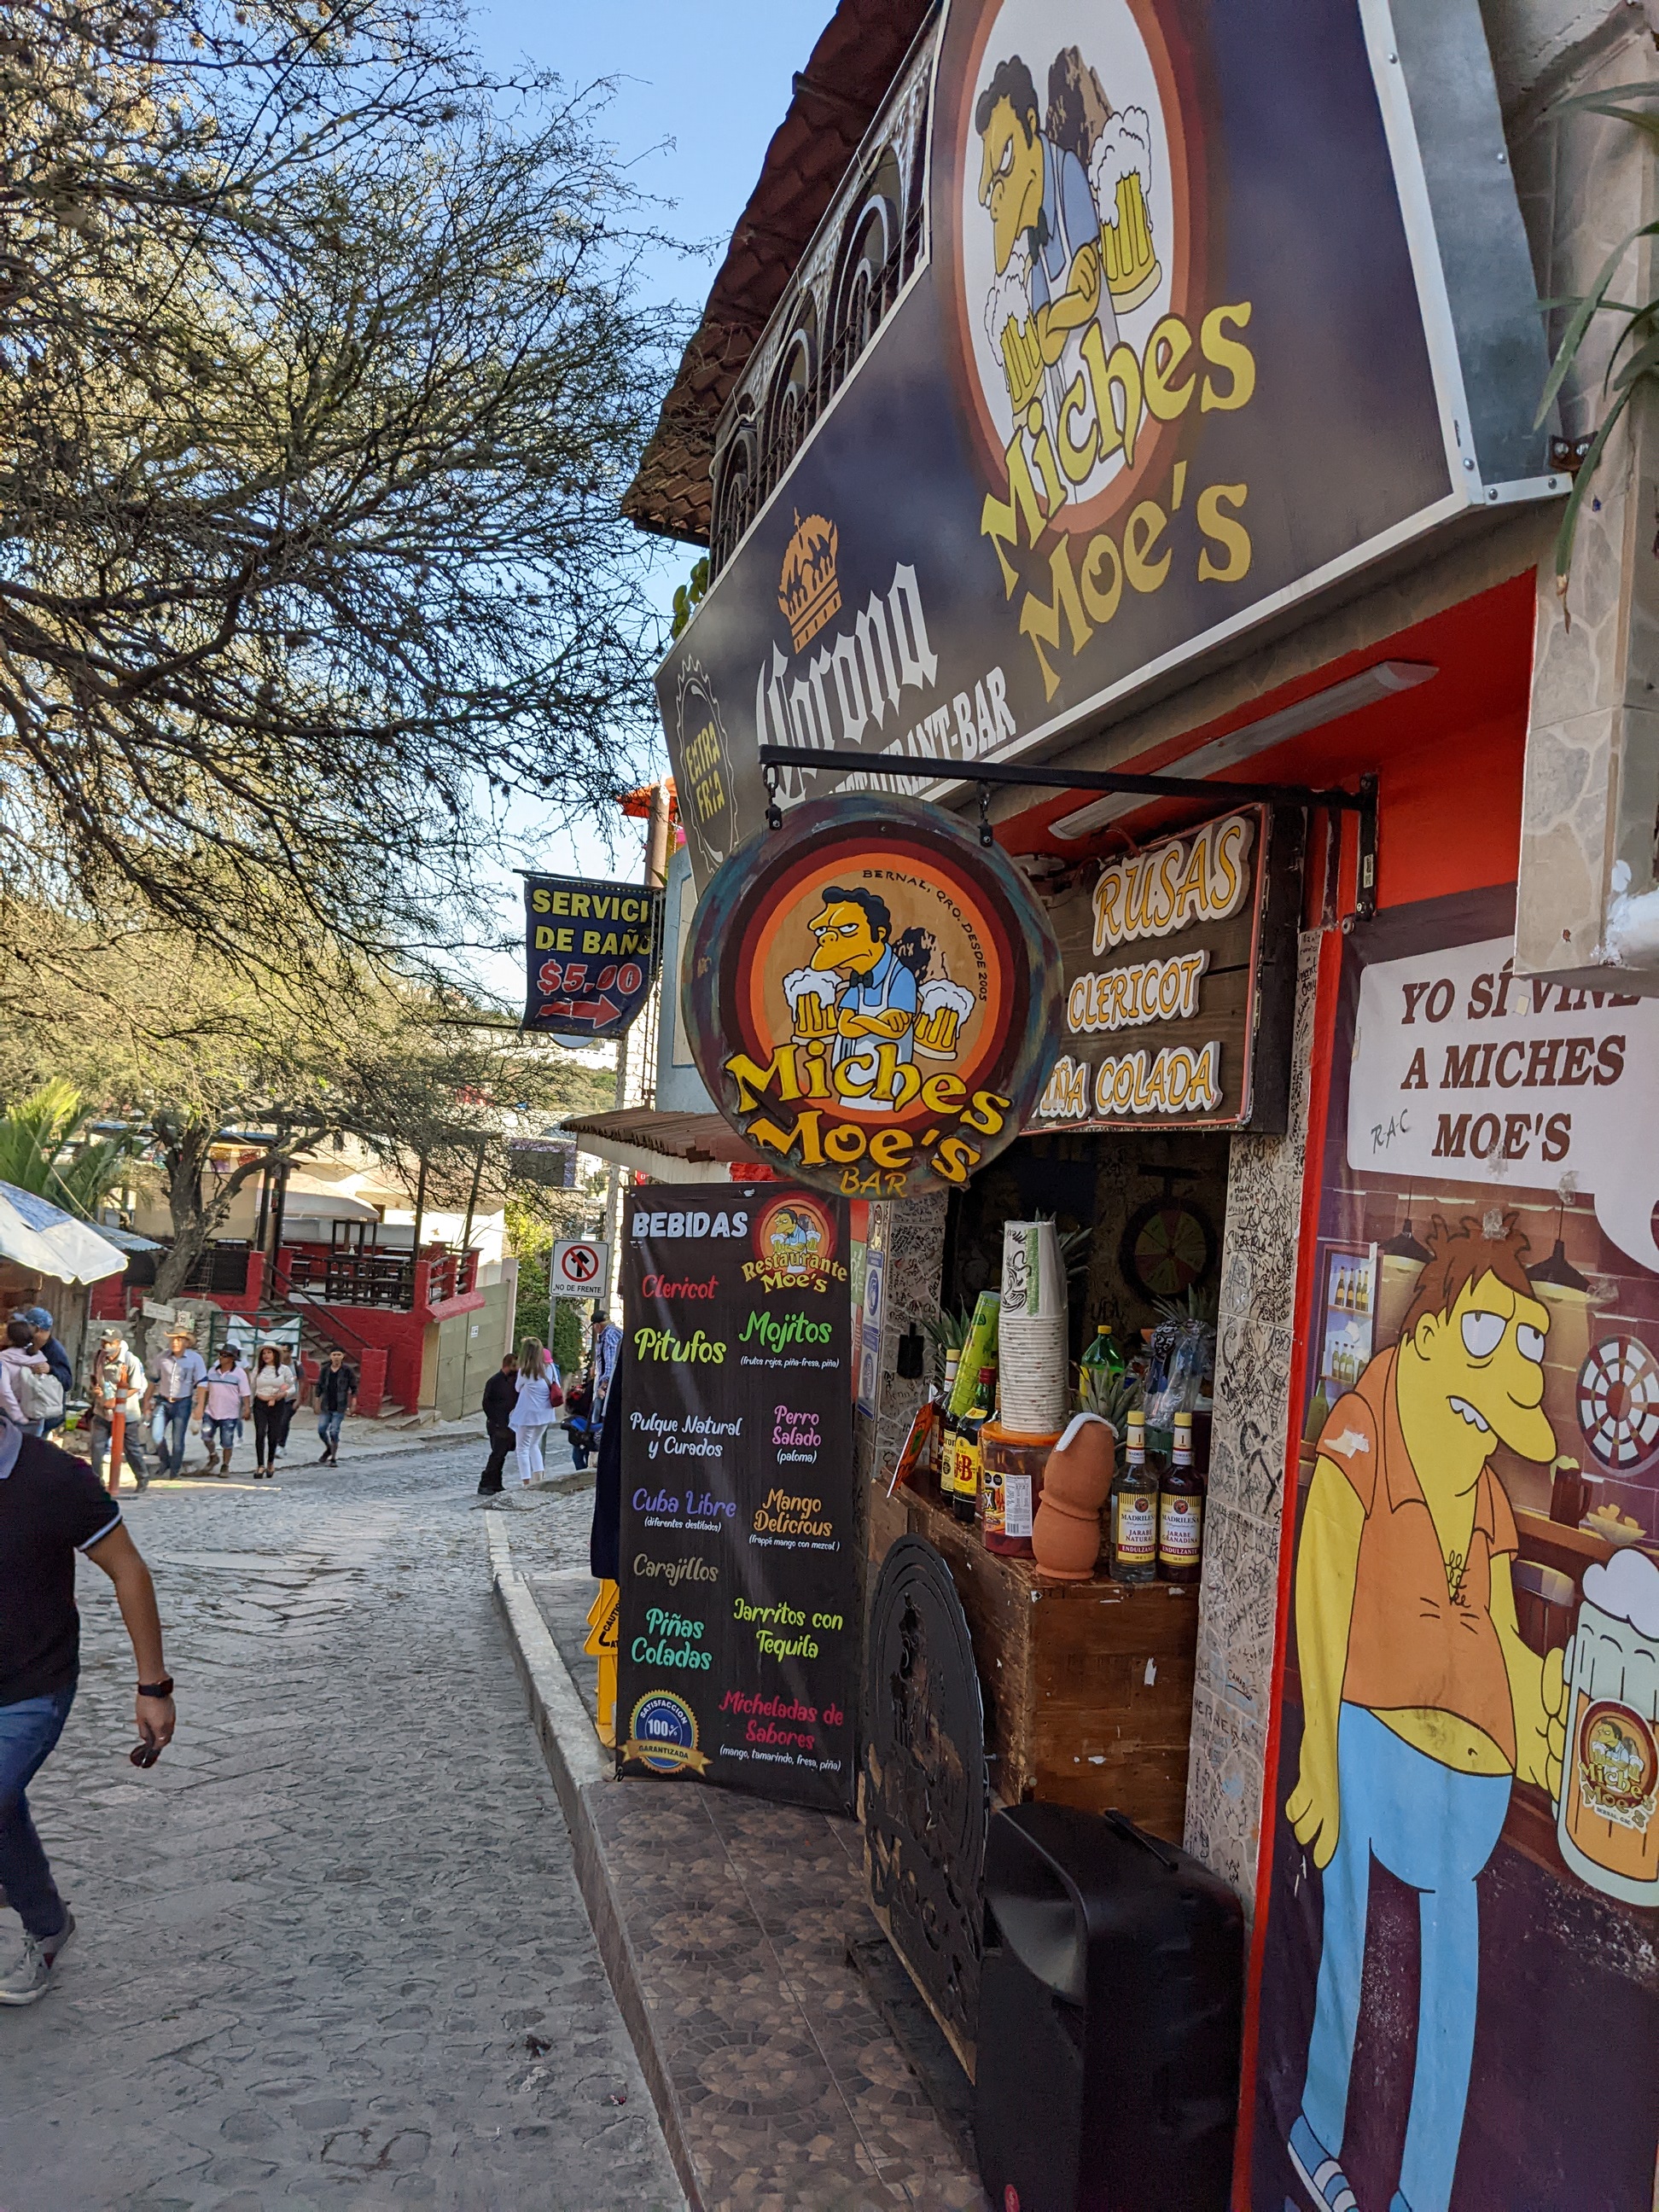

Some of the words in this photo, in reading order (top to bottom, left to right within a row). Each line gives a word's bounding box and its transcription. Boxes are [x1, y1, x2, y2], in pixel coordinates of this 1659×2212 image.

[981, 301, 1255, 601] Miches
[1020, 461, 1252, 701] Moe's
[756, 561, 938, 812] Corona
[1095, 824, 1242, 948] RUSAS
[532, 888, 649, 923] SERVICI
[535, 925, 574, 952] DE
[582, 928, 651, 956] BAÑO
[961, 922, 987, 969] DESDE
[978, 971, 987, 1002] 2005
[1068, 955, 1203, 1029] CLERICOT
[1401, 978, 1455, 1024] YO
[1400, 1047, 1429, 1090] A
[1439, 1035, 1626, 1089] MICHES
[725, 1039, 1011, 1136] Miches
[1042, 1062, 1085, 1112] IÑA
[1096, 1049, 1213, 1109] COLADA
[746, 1109, 982, 1184] Moe's
[1431, 1112, 1571, 1162] MOE'S
[839, 1166, 908, 1197] BAR
[632, 1212, 748, 1238] BEBIDAS
[742, 1252, 847, 1282] Restaurante
[760, 1271, 827, 1293] Moe's
[577, 1285, 602, 1294] FRENTE
[643, 1274, 719, 1299] Clericot
[634, 1327, 727, 1364] Pitufos
[739, 1310, 832, 1353] Mojitos
[630, 1412, 678, 1437] Pulque
[682, 1415, 742, 1436] Natural
[774, 1405, 819, 1426] Perro
[648, 1441, 659, 1459] y
[664, 1436, 723, 1457] Curados
[771, 1426, 822, 1447] Salado
[777, 1448, 818, 1464] (paloma)
[632, 1487, 679, 1513] Cuba
[685, 1490, 736, 1517] Libre
[762, 1487, 822, 1519] Mango
[644, 1516, 683, 1528] (diferentes
[754, 1509, 832, 1537] Delicious
[773, 1540, 796, 1550] mango
[633, 1552, 719, 1586] Carajillos
[603, 1603, 620, 1632] CAUTIO
[646, 1608, 704, 1639] Piñas
[733, 1598, 806, 1626] Jarritos
[812, 1612, 843, 1631] con
[632, 1636, 713, 1670] Coladas
[755, 1629, 819, 1662] Tequila
[639, 1699, 687, 1725] SATISFACCION
[719, 1689, 818, 1723] Micheladas
[823, 1703, 843, 1726] de
[745, 1719, 815, 1750] Sabores
[638, 1745, 690, 1760] GARANTIZADA
[719, 1743, 749, 1760] (mango,
[1579, 1761, 1654, 1811] Miches
